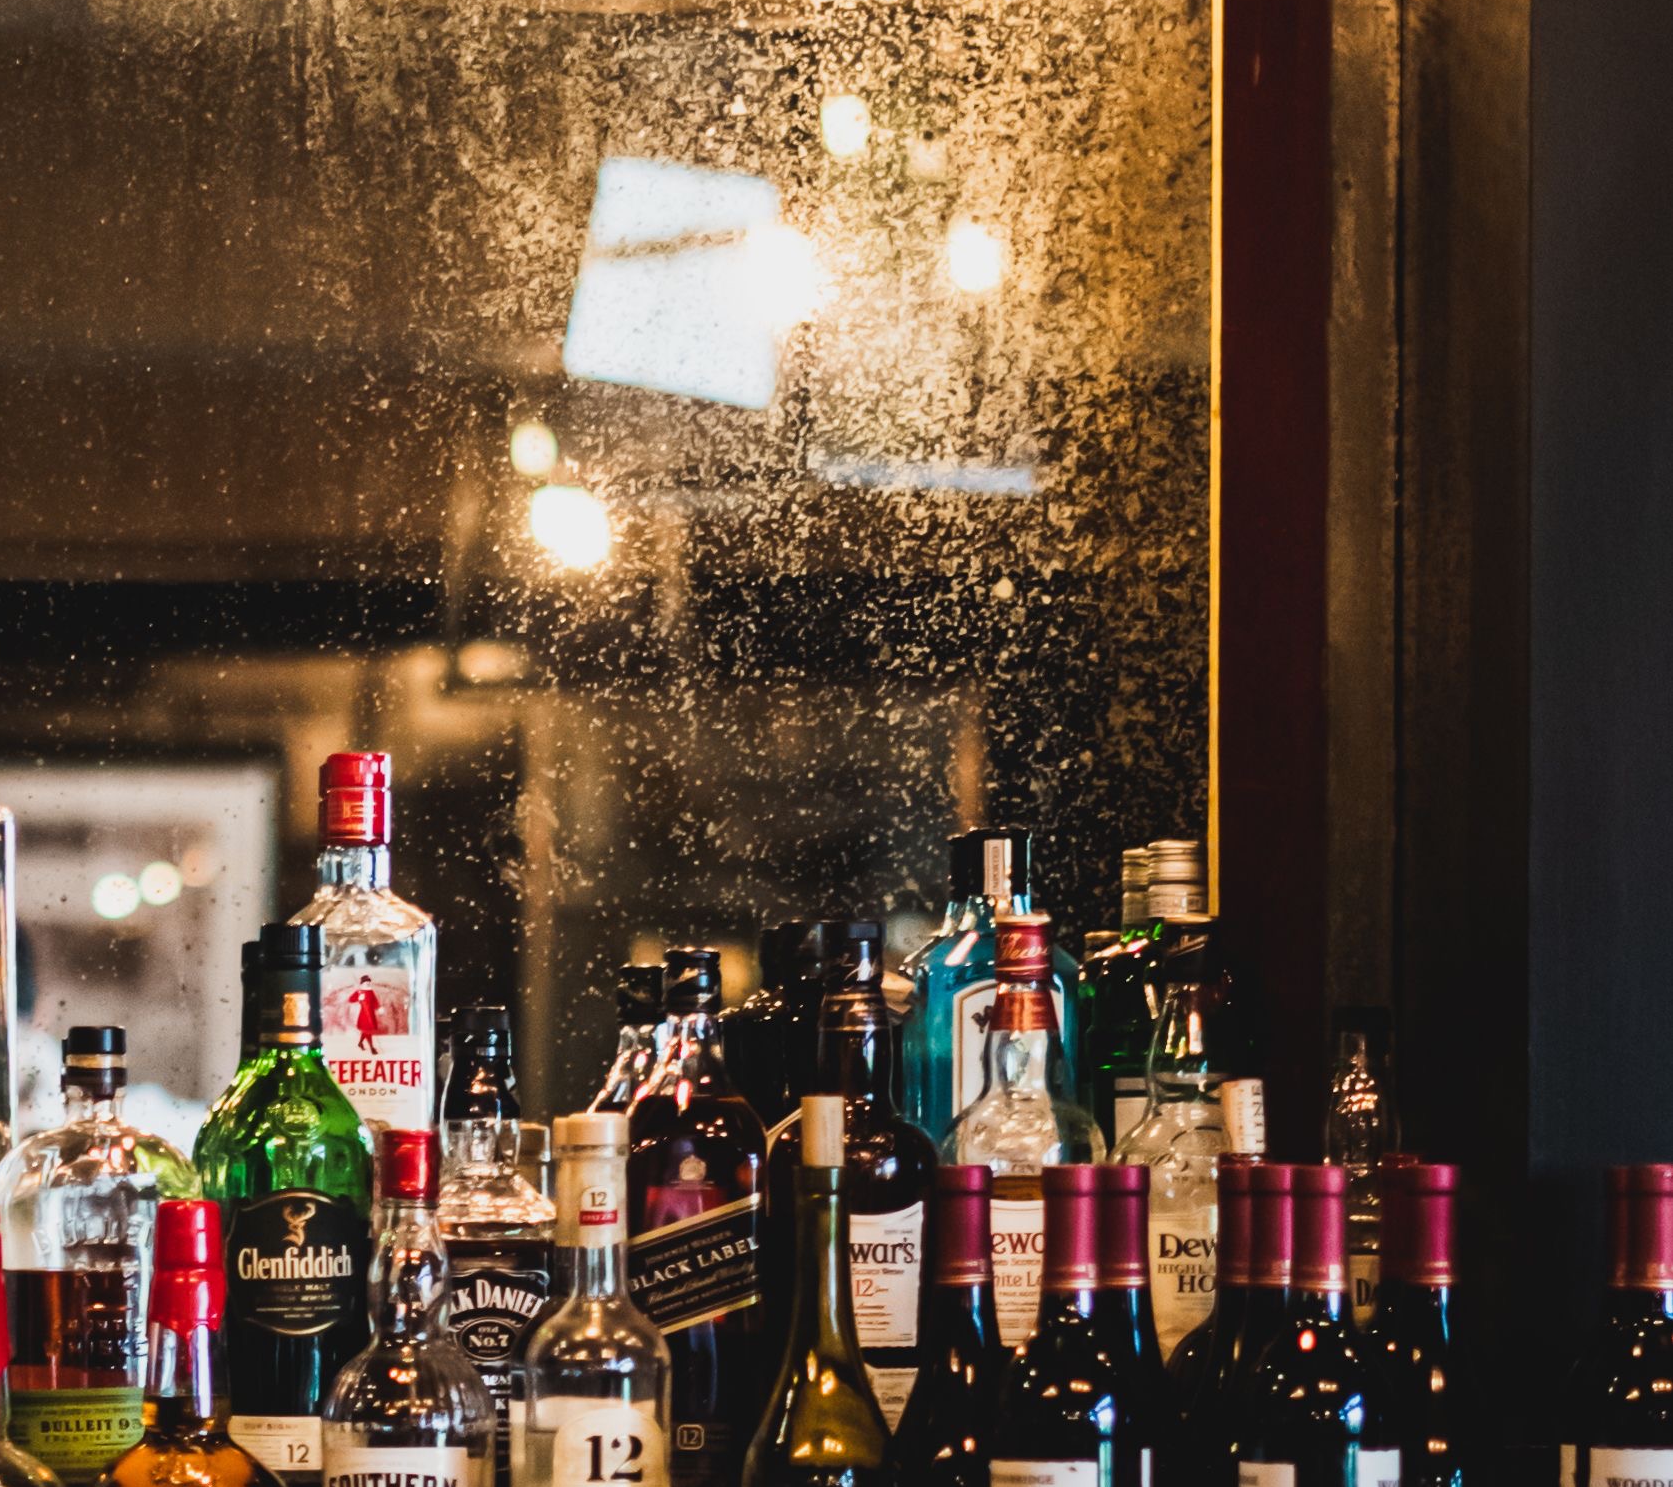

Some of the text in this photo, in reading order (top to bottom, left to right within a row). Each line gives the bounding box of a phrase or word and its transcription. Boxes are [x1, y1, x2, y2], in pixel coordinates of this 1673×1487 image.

[589, 1191, 608, 1208] 12
[237, 1244, 353, 1281] Glenfiddich
[696, 1235, 760, 1268] LABEL
[40, 1418, 113, 1434] BULLEIT
[286, 1443, 310, 1464] 12
[584, 1434, 644, 1484] 12
